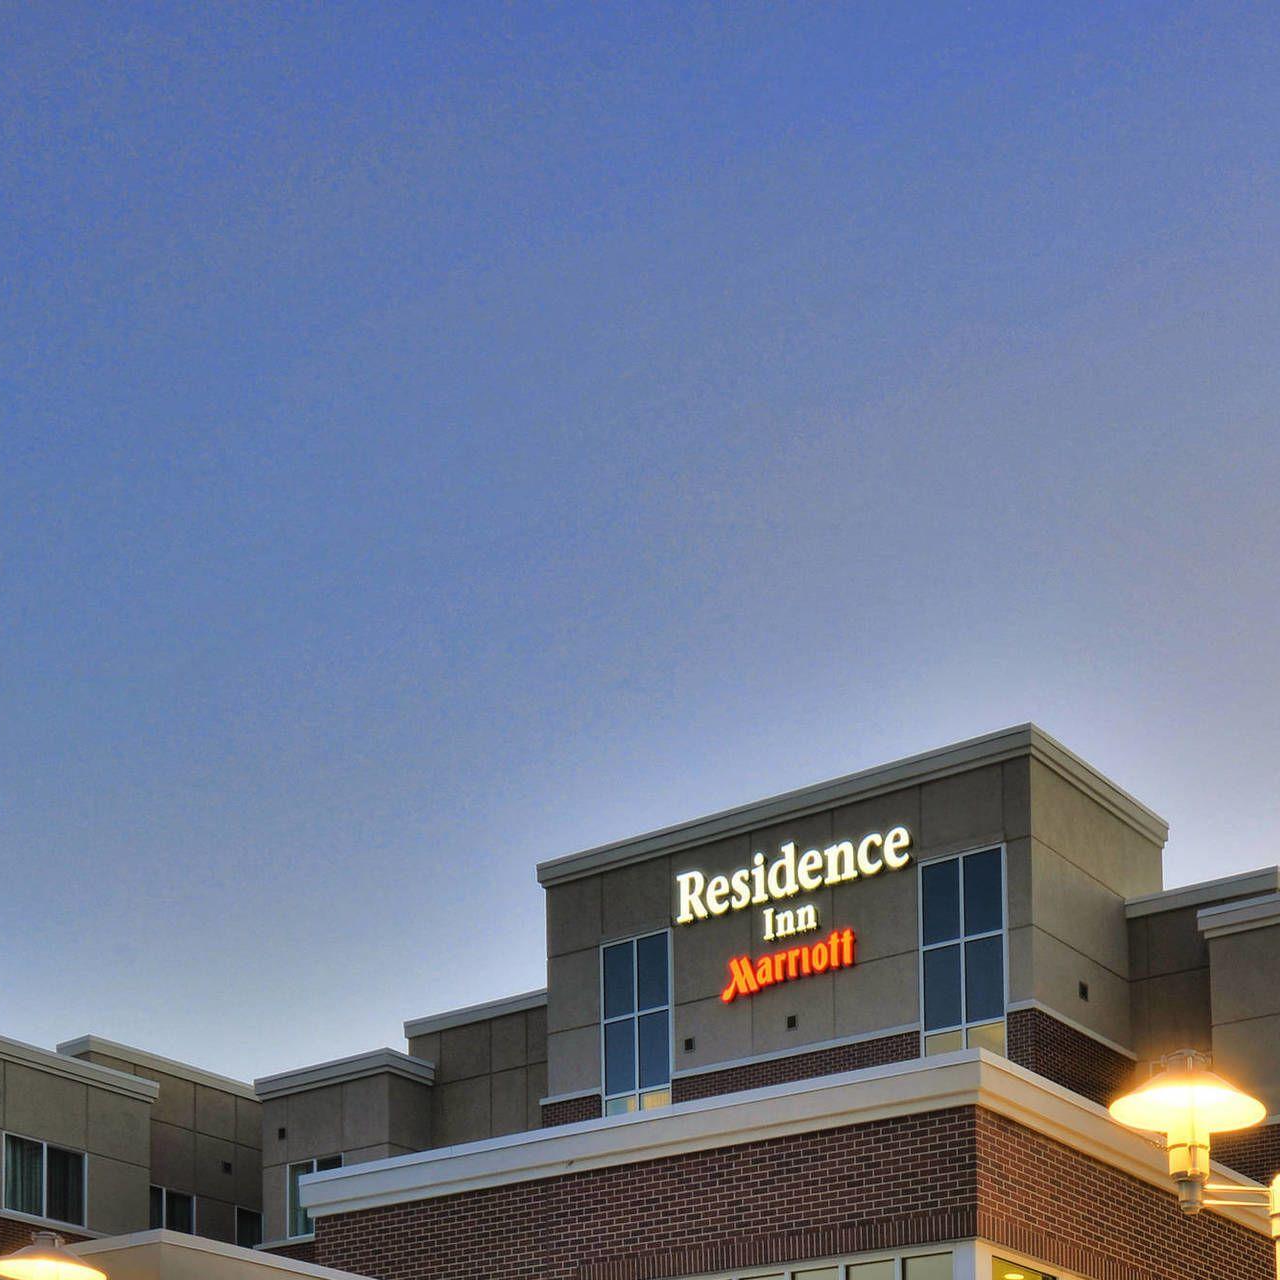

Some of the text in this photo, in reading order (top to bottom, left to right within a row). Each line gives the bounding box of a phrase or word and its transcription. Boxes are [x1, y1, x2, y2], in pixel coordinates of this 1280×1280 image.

[675, 825, 911, 924] Residence
[762, 903, 818, 941] Inn
[721, 927, 856, 1004] Marriott
